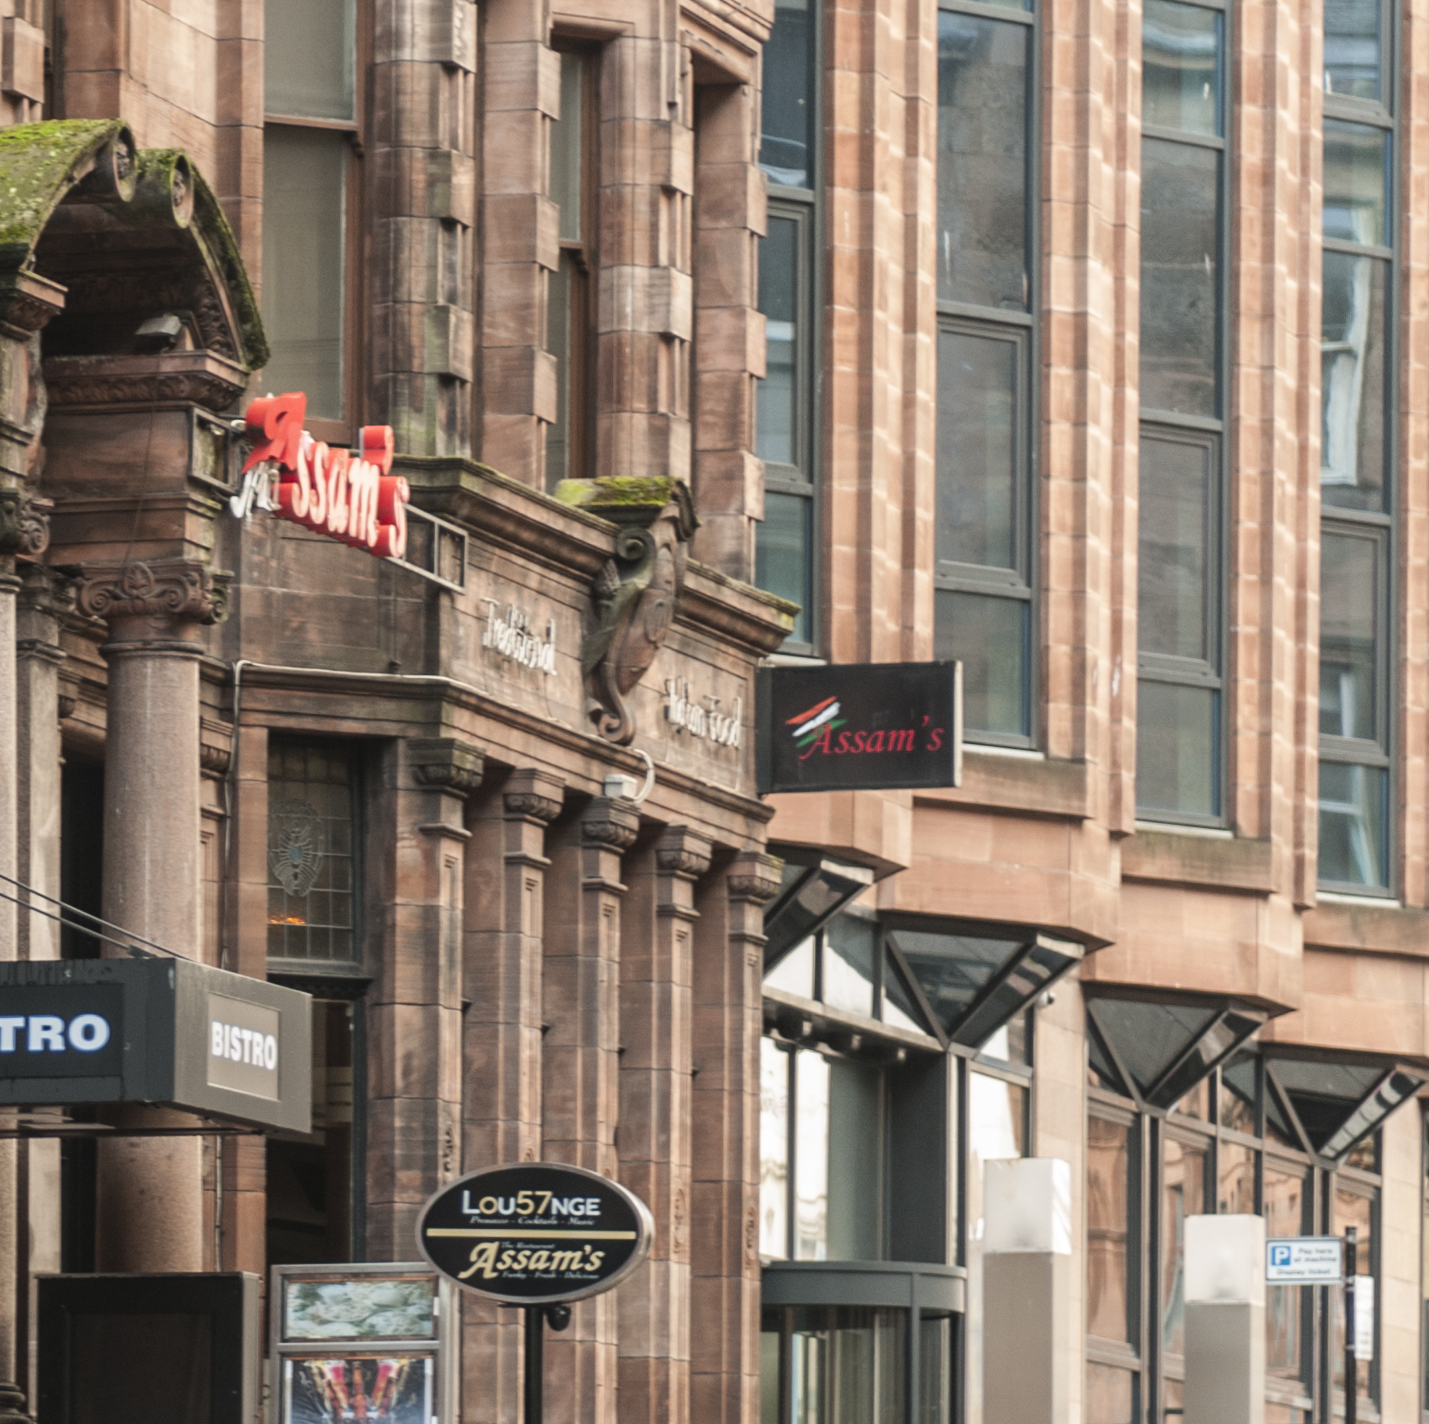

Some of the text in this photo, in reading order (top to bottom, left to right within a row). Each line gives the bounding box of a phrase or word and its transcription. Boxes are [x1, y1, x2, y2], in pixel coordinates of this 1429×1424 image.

[798, 714, 945, 761] Assam's
[210, 1020, 279, 1072] BISTRO
[457, 1241, 606, 1279] Assam's
